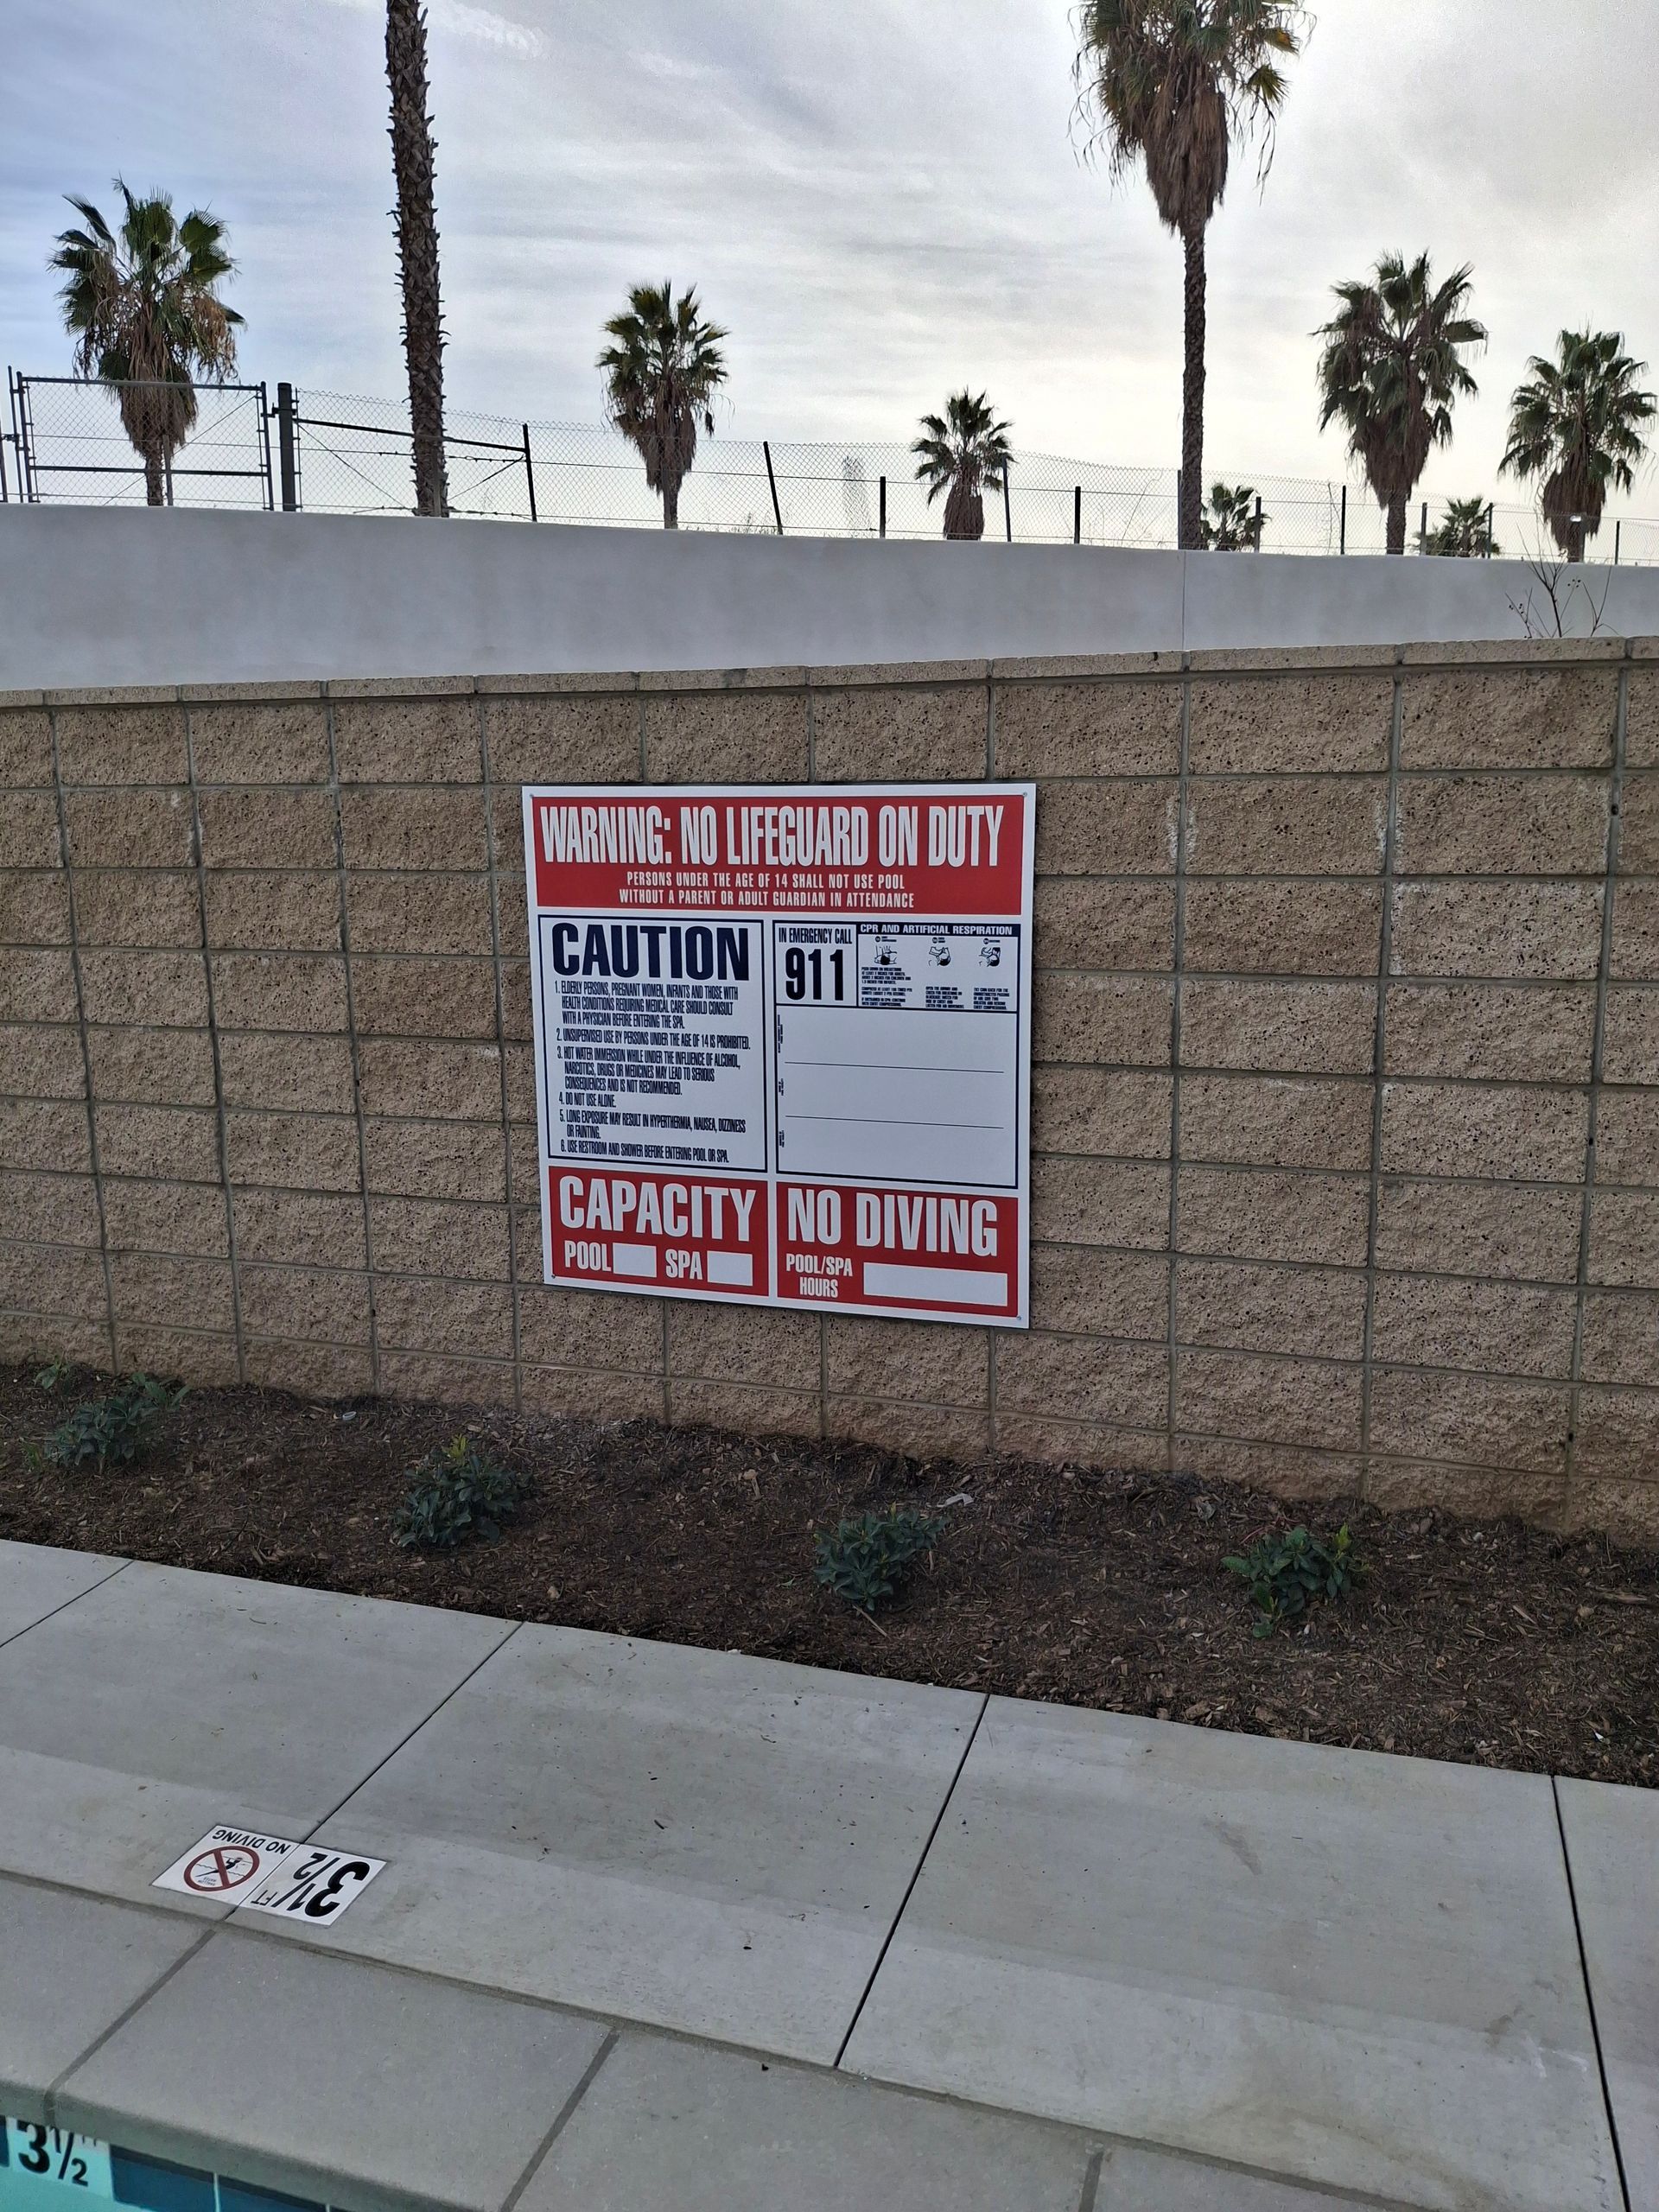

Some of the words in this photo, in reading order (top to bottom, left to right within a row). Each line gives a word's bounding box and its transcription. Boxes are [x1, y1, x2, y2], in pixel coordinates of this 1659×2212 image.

[540, 805, 671, 865] WARNING:
[680, 805, 717, 866] NO
[726, 805, 868, 867] LIFEGUARD
[879, 804, 918, 867] ON
[928, 805, 1003, 867] DUTY
[627, 871, 672, 887] PERSONS
[677, 872, 709, 887] UNDER
[713, 873, 731, 887] THE
[735, 873, 753, 887] AGE
[758, 874, 770, 888] OF
[775, 874, 788, 888] 14
[792, 874, 823, 888] SHALL
[829, 874, 849, 889] NOT
[855, 874, 874, 889] USE
[878, 874, 905, 890] POOL
[620, 889, 664, 904] WITHOUT
[669, 890, 675, 904] A
[679, 890, 716, 905] PARENT
[721, 891, 734, 906] OR
[739, 891, 768, 906] ADULT
[773, 892, 825, 906] GUARDIAN
[830, 893, 842, 906] IN
[847, 893, 914, 908] ATTENDANCE
[779, 927, 787, 943] IN
[789, 928, 832, 944] EMERGENCY
[835, 930, 853, 944] CALL
[861, 924, 878, 933] CPR
[880, 925, 899, 934] AND
[903, 925, 950, 935] ARTIFICIAL
[952, 925, 1012, 936] RESPIRATION
[551, 922, 749, 981] CAUTION
[785, 947, 844, 1001] 911
[562, 980, 582, 995] ELDERLY
[612, 982, 640, 996] PREGNANT
[666, 984, 690, 999] INFANTS
[691, 985, 703, 999] AND
[704, 986, 722, 1000] THOSE
[723, 986, 738, 1001] WITH
[562, 995, 581, 1009] HEALTH
[582, 996, 614, 1011] CONDITIONS
[615, 998, 645, 1013] REQUIRING
[645, 999, 670, 1013] MEDICAL
[671, 999, 684, 1014] CARE
[686, 1000, 707, 1014] SHOULD
[709, 1001, 734, 1015] CONSULT
[563, 1011, 576, 1024] WITH
[577, 1011, 582, 1025] A
[582, 1012, 611, 1026] PHYSICIAN
[613, 1013, 632, 1027] BEFORE
[633, 1014, 660, 1028] ENTERING
[661, 1014, 671, 1028] THE
[563, 1028, 602, 1043] UNSUPERVISED
[603, 1030, 614, 1044] USE
[615, 1030, 622, 1044] BY
[624, 1031, 649, 1045] PERSONS
[650, 1032, 669, 1046] UNDER
[670, 1033, 680, 1046] THE
[681, 1033, 691, 1047] AGE
[692, 1033, 700, 1047] OF
[702, 1034, 709, 1048] 14
[710, 1034, 715, 1048] IS
[564, 1046, 574, 1059] HOT
[575, 1046, 593, 1060] WATER
[594, 1047, 626, 1062] IMMERSION
[626, 1049, 644, 1063] WHILE
[645, 1050, 663, 1064] UNDER
[664, 1051, 674, 1065] THE
[675, 1052, 705, 1065] INFLUENCE
[706, 1052, 713, 1066] OF
[597, 1063, 614, 1077] DRUGS
[616, 1064, 624, 1077] OR
[625, 1064, 654, 1078] MEDICINES
[655, 1065, 667, 1079] MAY
[669, 1066, 682, 1080] LEAD
[683, 1067, 690, 1081] TO
[691, 1067, 715, 1082] SERIOUS
[564, 1076, 607, 1091] CONSEQUENCES
[607, 1078, 619, 1091] AND
[620, 1078, 626, 1092] IS
[626, 1079, 638, 1093] NOT
[565, 1092, 573, 1105] DO
[574, 1092, 585, 1106] NOT
[586, 1093, 596, 1107] USE
[566, 1109, 580, 1123] LONG
[582, 1109, 608, 1125] EXPOSURE
[609, 1111, 621, 1125] MAY
[622, 1112, 641, 1127] RESULT
[642, 1113, 649, 1127] IN
[718, 1118, 746, 1133] DIZZINESS
[567, 1123, 575, 1137] OR
[567, 1140, 577, 1154] USE
[578, 1140, 607, 1154] RESTROOM
[608, 1141, 620, 1156] AND
[620, 1142, 643, 1158] SHOWER
[644, 1144, 664, 1159] BEFORE
[664, 1146, 692, 1161] ENTERING
[692, 1147, 707, 1162] POOL
[708, 1147, 716, 1162] OR
[559, 1175, 757, 1242] CAPACITY
[787, 1187, 842, 1245] NO
[855, 1192, 998, 1257] DIVING
[564, 1240, 611, 1272] POOL
[665, 1249, 702, 1280] SPA
[785, 1253, 853, 1276] POOL/SPA
[799, 1276, 838, 1298] HOURS
[212, 1829, 266, 1848] DIVING
[265, 1840, 291, 1854] NO
[251, 1890, 278, 1906] FT
